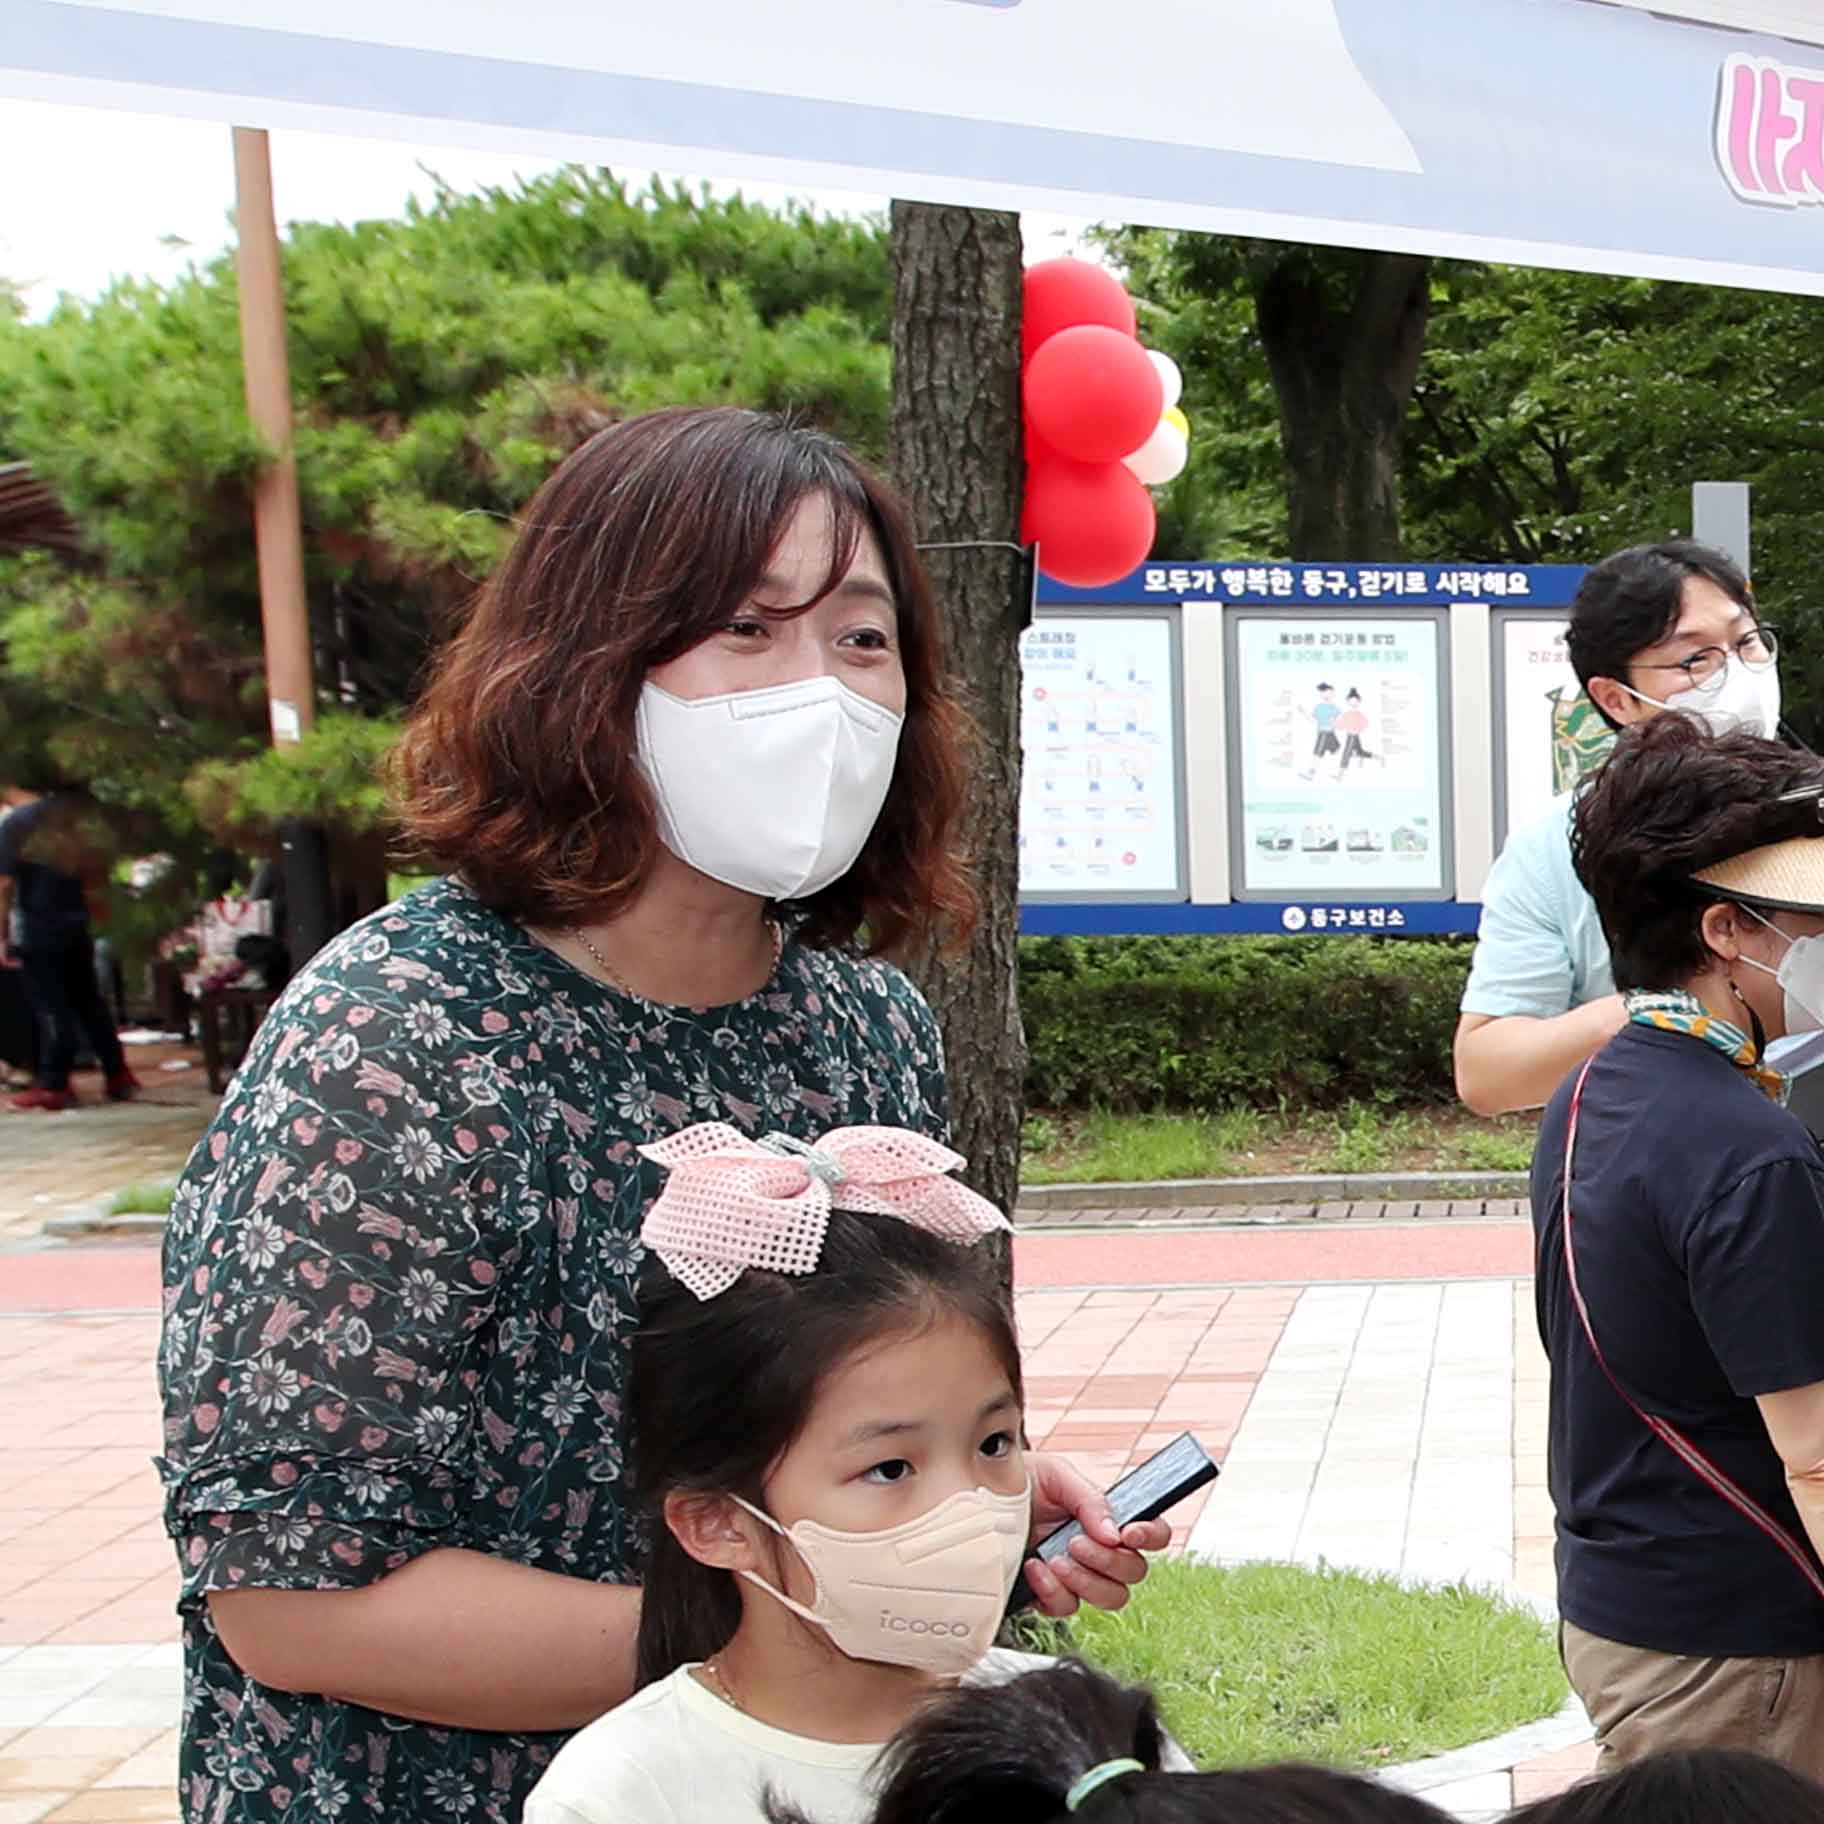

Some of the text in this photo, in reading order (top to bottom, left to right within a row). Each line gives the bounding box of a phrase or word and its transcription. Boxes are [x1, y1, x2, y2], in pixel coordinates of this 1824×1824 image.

[1144, 569, 1216, 594] 모두가
[1222, 569, 1293, 596] 행복한
[1436, 571, 1530, 597] 시작해요
[1310, 908, 1405, 928] 동구보건소
[879, 1608, 971, 1638] icoco
